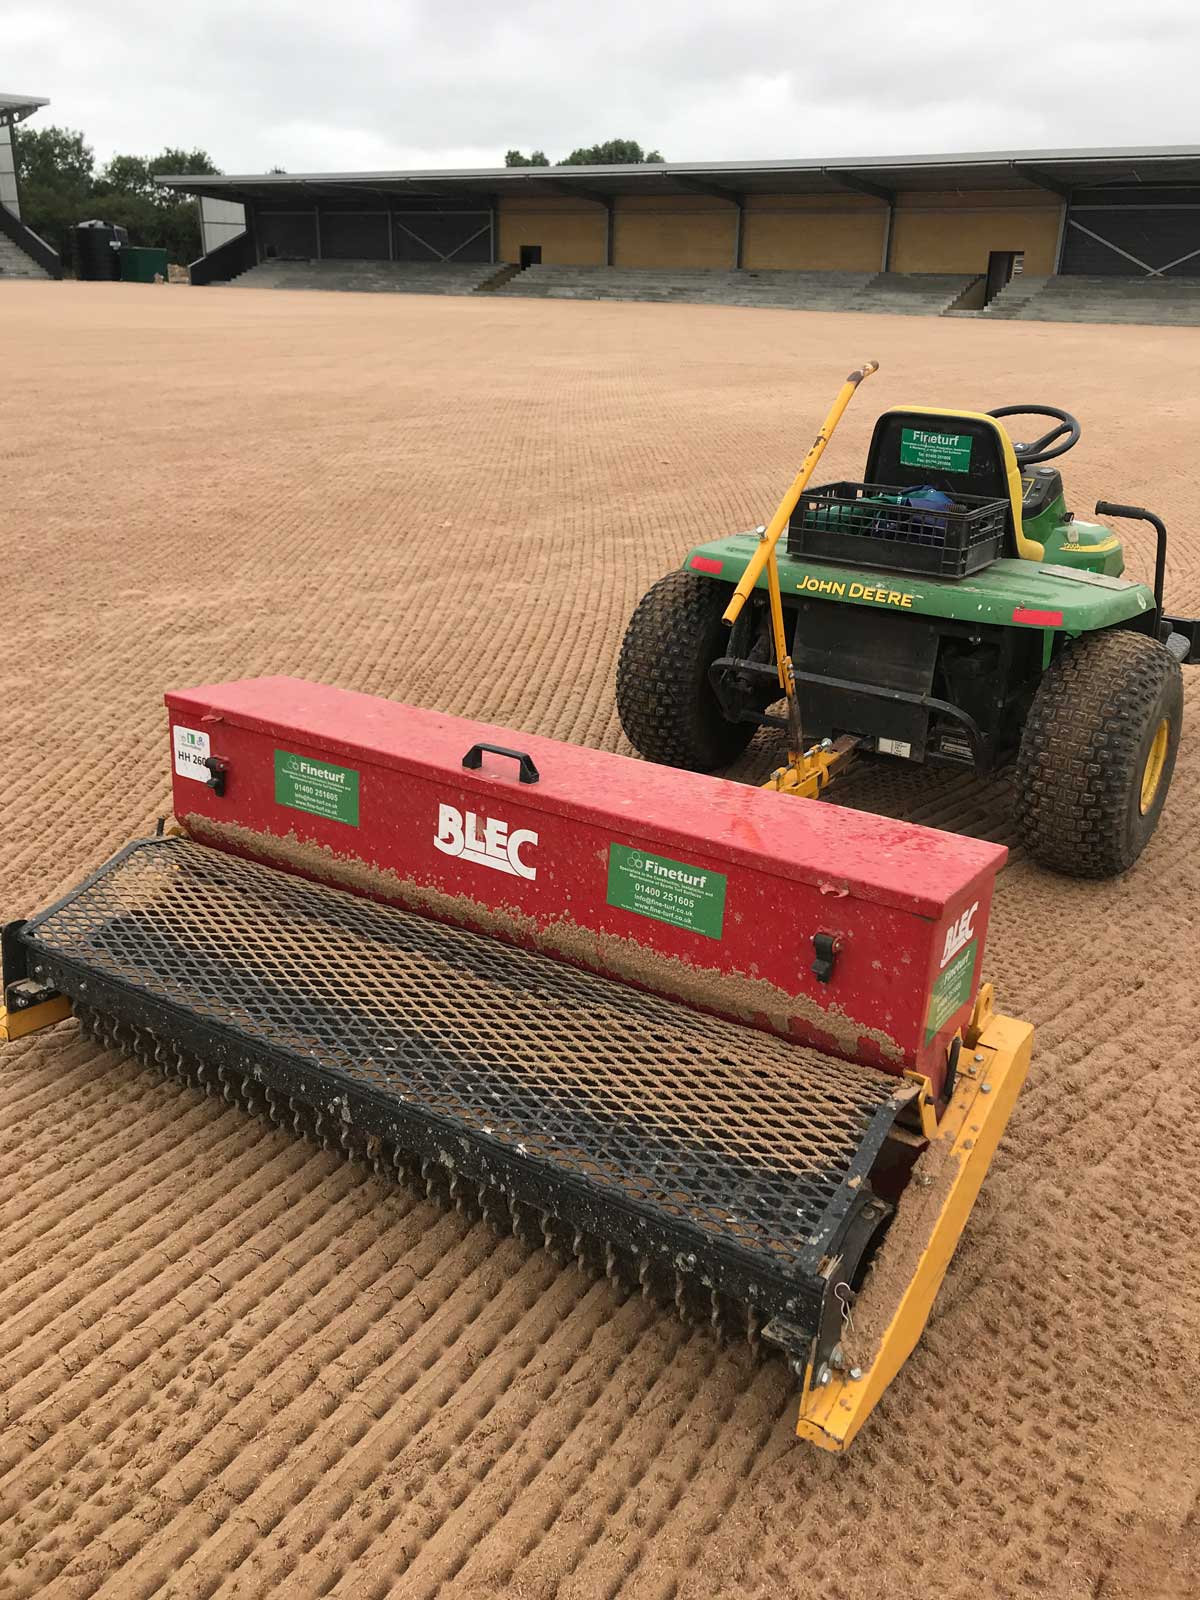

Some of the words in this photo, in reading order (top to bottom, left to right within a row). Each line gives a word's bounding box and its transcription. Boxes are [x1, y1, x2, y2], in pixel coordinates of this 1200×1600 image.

[796, 575, 846, 596] JOHN
[848, 582, 913, 608] DEERE
[178, 750, 191, 762] HH
[300, 761, 346, 784] Fineturf
[294, 782, 314, 794] 01400
[315, 788, 338, 802] 251605
[433, 803, 539, 881] BLEC
[644, 859, 708, 889] Fineturf
[634, 882, 660, 898] 01400
[662, 891, 695, 909] 251605
[940, 900, 979, 969] BLEC
